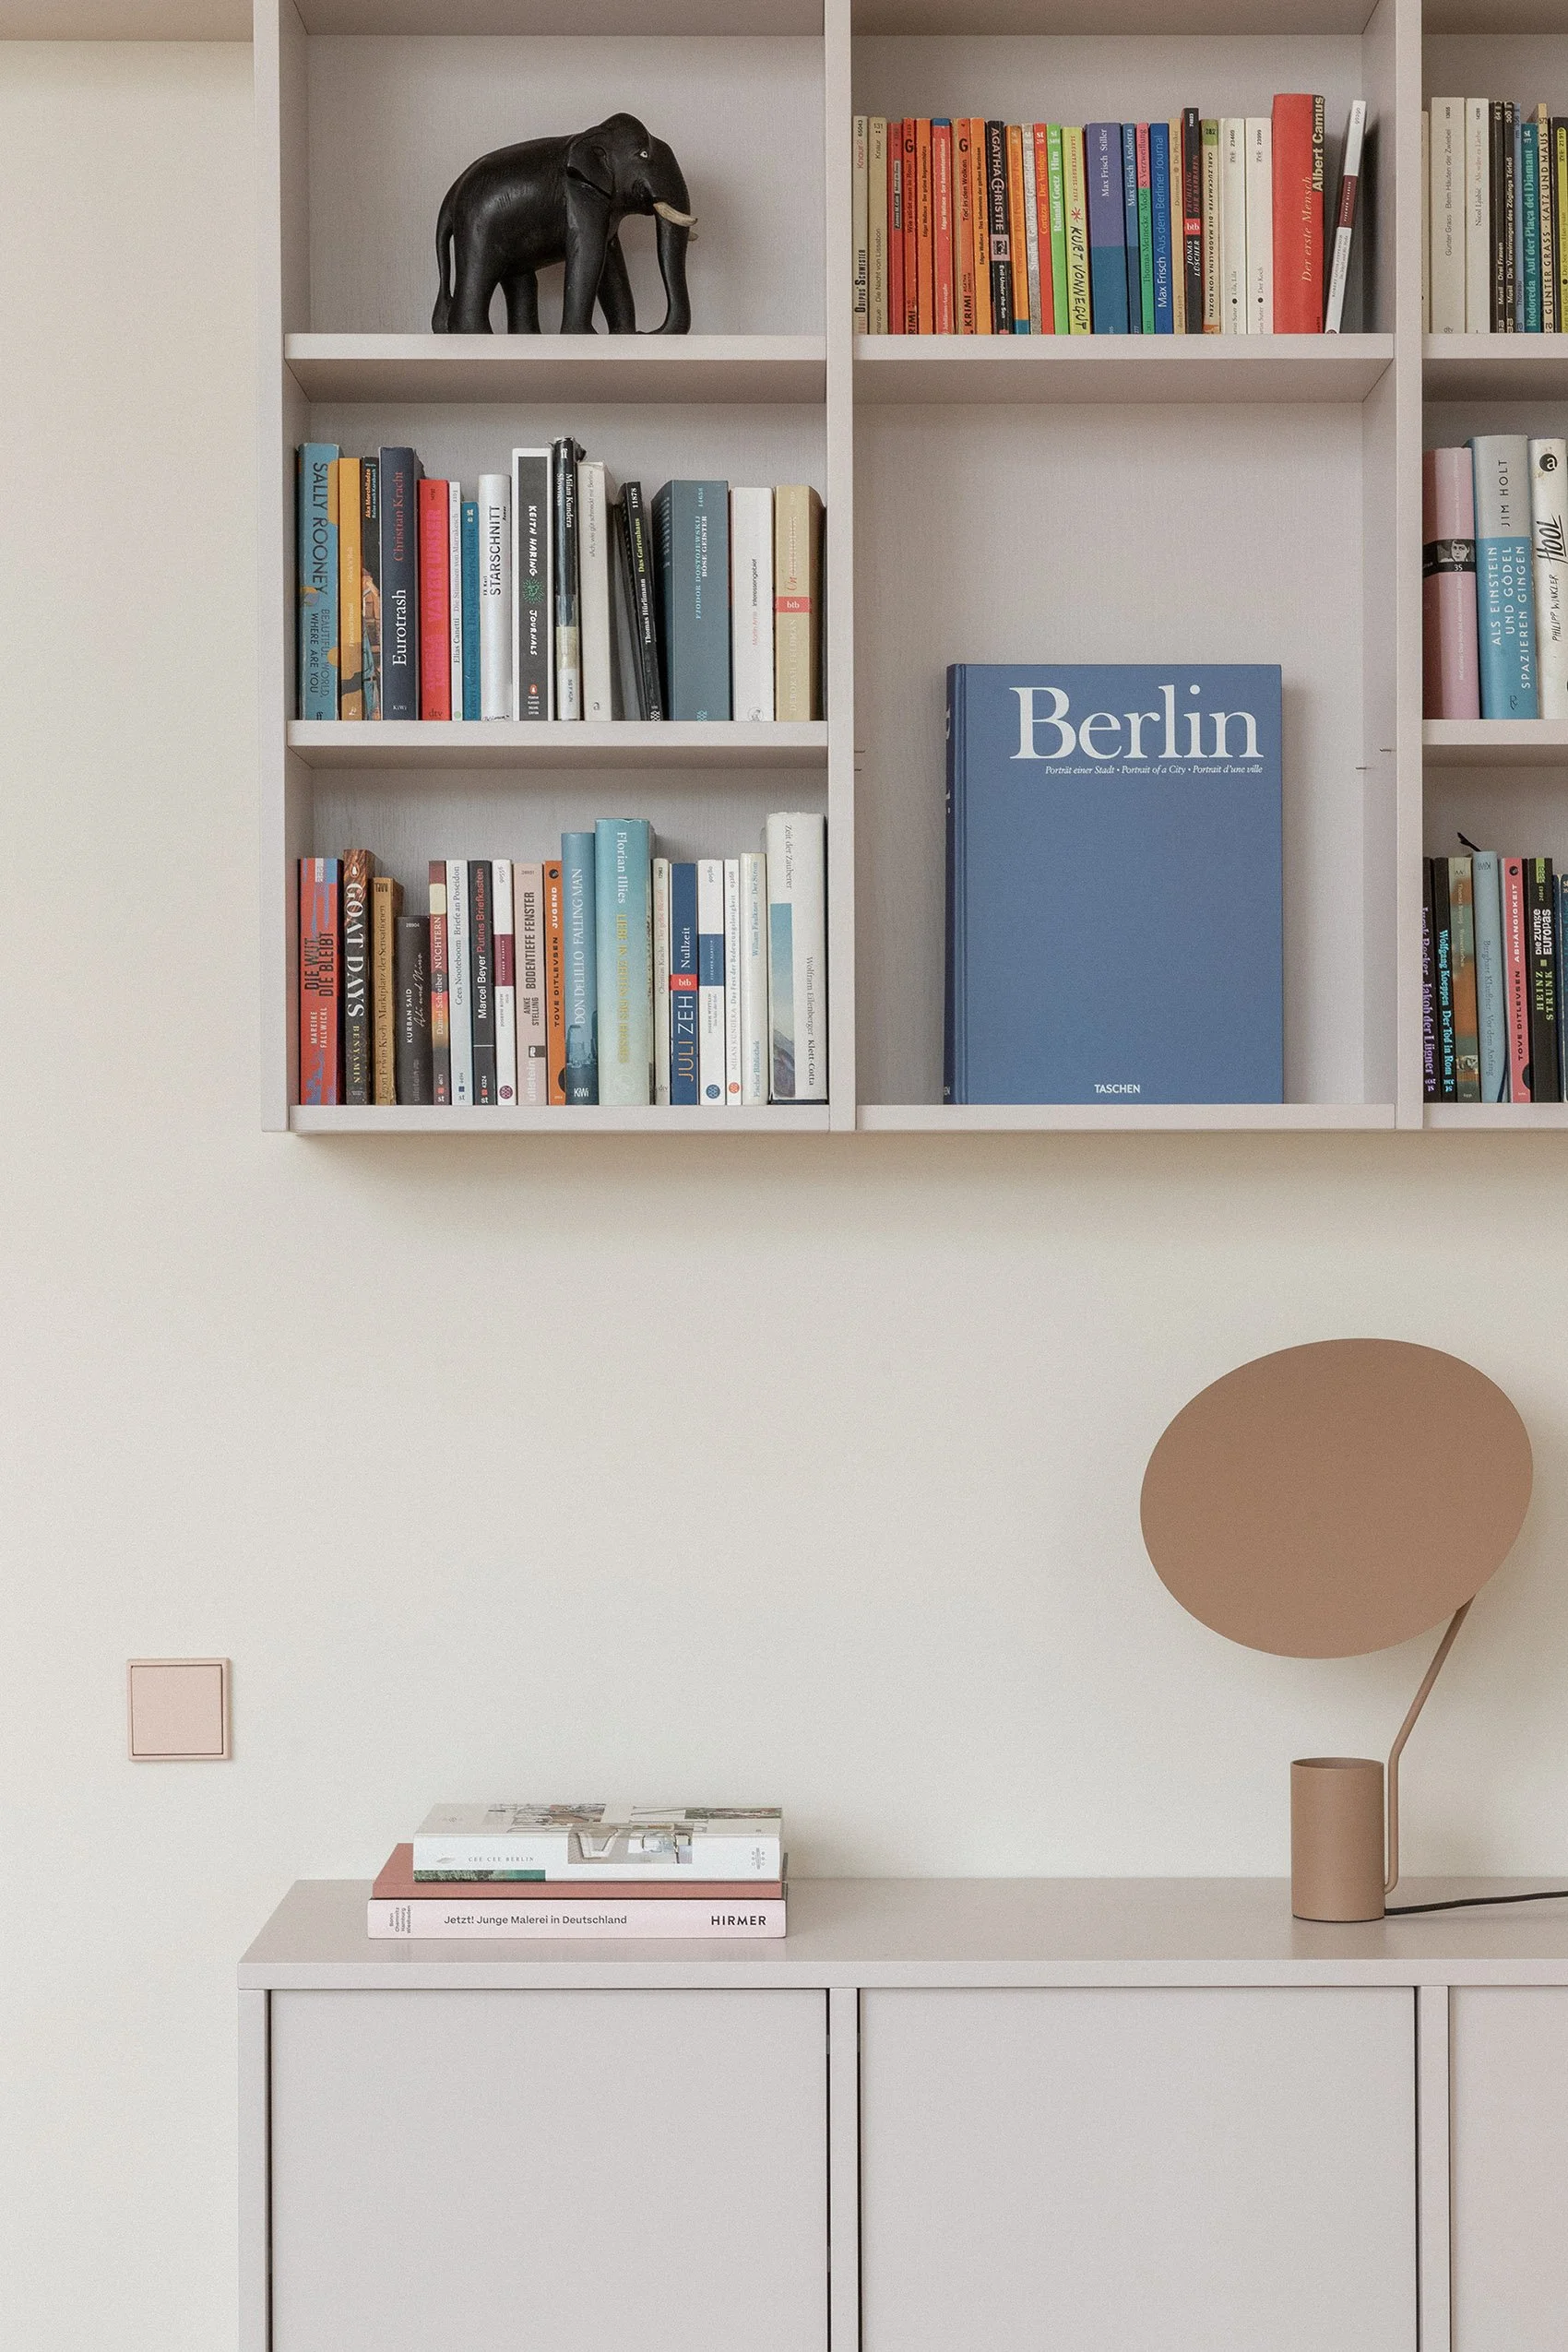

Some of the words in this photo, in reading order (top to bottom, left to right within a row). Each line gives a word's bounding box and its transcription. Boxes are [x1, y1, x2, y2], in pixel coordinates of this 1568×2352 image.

[1313, 96, 1324, 144] Camus
[991, 128, 1000, 177] AGATHA
[1099, 129, 1108, 150] Stiller
[1125, 129, 1134, 160] Andorra
[1154, 136, 1164, 170] Journal
[1539, 133, 1549, 162] MAUS
[1051, 151, 1059, 171] Hirn
[1100, 155, 1109, 178] Frisch
[1313, 148, 1324, 192] Albert
[1525, 150, 1534, 192] Diamant
[1540, 167, 1549, 189] UND
[1051, 175, 1062, 199] Goetz
[1101, 180, 1110, 196] Max
[1155, 173, 1164, 208] Berliner
[1301, 176, 1312, 222] Mensch
[1525, 194, 1535, 208] del
[992, 178, 1005, 231] CHRISTIE
[1052, 202, 1062, 232] Rainald
[1541, 192, 1550, 220] KATZ
[1156, 212, 1165, 232] dem
[1526, 210, 1537, 235] Plaça
[1070, 226, 1084, 260] KURT
[1156, 234, 1165, 254] Aus
[1302, 228, 1312, 255] erste
[1526, 237, 1536, 255] der
[1542, 232, 1551, 267] GRASS
[1157, 256, 1167, 283] Frisch
[1301, 257, 1312, 281] Der
[1526, 255, 1536, 275] Auf
[1073, 265, 1087, 329] VONNEGUT
[1158, 286, 1167, 307] Max
[1526, 280, 1537, 327] Rodoreda
[1544, 271, 1553, 315] GÜNTER
[313, 462, 328, 510] SALLY
[393, 471, 404, 507] Kracht
[556, 473, 564, 506] Slowness
[565, 473, 574, 495] Milan
[1498, 459, 1509, 496] HOLT
[565, 497, 574, 528] Kundera
[631, 487, 639, 509] 11878
[528, 505, 538, 535] KEITH
[1500, 505, 1511, 527] JIM
[393, 510, 405, 562] Christian
[489, 505, 501, 596] STARSCHNITT
[634, 518, 644, 558] Gartenhaus
[1536, 513, 1566, 563] HOOL
[312, 517, 328, 596] ROONEY
[528, 538, 538, 576] HARING
[1501, 546, 1514, 597] GÖDEL
[1515, 545, 1527, 602] GINGEN
[1488, 546, 1500, 612] EINSTEIN
[1548, 575, 1561, 609] WINKLER
[639, 578, 649, 616] Hürlimann
[310, 613, 319, 647] WHERE
[320, 609, 330, 658] BEAUTIFUL
[392, 589, 407, 666] Eurotrash
[528, 610, 538, 656] JOURNALS
[643, 616, 652, 644] Thomas
[1491, 620, 1502, 646] ALS
[1503, 605, 1515, 634] UND
[1550, 612, 1562, 642] PHILIPP
[310, 650, 319, 669] ARE
[1518, 611, 1531, 689] SPAZIEREN
[310, 671, 319, 694] YOU
[320, 661, 330, 698] WORLD,
[1009, 683, 1265, 760] Berlin
[1045, 765, 1073, 775] Porträt
[1074, 766, 1093, 775] einer
[1094, 765, 1114, 775] Stadt
[1122, 765, 1150, 775] Portrait
[1152, 765, 1161, 776] of
[1169, 765, 1186, 776] City
[1193, 765, 1221, 775] Portrait
[1223, 765, 1244, 775] d'une
[1246, 765, 1263, 774] ville
[616, 832, 626, 873] Florian
[452, 866, 461, 900] Poseidon
[475, 868, 485, 921] Briefkasten
[572, 869, 583, 897] MAN
[617, 875, 628, 904] Illies
[345, 884, 364, 950] GOAT
[452, 914, 462, 935] Briefe
[455, 902, 461, 913] an
[524, 892, 536, 932] FENSTER
[573, 899, 584, 944] FALLING
[1511, 884, 1520, 963] ABHÄNGIGKEIT
[433, 917, 442, 968] NÜCHTERN
[476, 923, 485, 953] Putins
[681, 927, 691, 968] Nullzeit
[1438, 930, 1449, 968] Wolfgang
[1542, 909, 1552, 955] Europas
[319, 932, 333, 971] BLEIBT
[453, 940, 463, 985] Nooteboom
[524, 933, 536, 990] BODENTIEFE
[304, 971, 319, 990] DIE
[346, 956, 364, 1017] DAYS
[476, 956, 488, 983] Beyer
[805, 956, 814, 991] Wolfram
[319, 978, 333, 996] DIE
[434, 973, 443, 1008] Schreiber
[455, 987, 463, 1005] Cees
[476, 985, 488, 1018] Marcel
[1440, 970, 1450, 1005] Koeppen
[1515, 970, 1523, 1029] DITLEVSEN
[1536, 971, 1544, 1010] HEINZ
[1545, 971, 1553, 1020] STRUNK
[435, 1010, 444, 1035] Daniel
[523, 997, 531, 1015] ANKE
[530, 997, 540, 1026] STELLING
[574, 1000, 586, 1024] DON
[677, 995, 694, 1034] ZEH
[805, 992, 815, 1036] Eilenberger
[1442, 1010, 1452, 1026] Der
[1443, 1028, 1453, 1044] Tod
[352, 1025, 361, 1084] BENYAMIN
[678, 1040, 695, 1082] JULI
[807, 1039, 816, 1086] Klett-Cotta
[1444, 1055, 1454, 1075] Rom
[1094, 1084, 1140, 1093] TASCHEN
[444, 1915, 474, 1925] Jetzt!
[476, 1915, 508, 1927] Junge
[510, 1915, 548, 1925] Malerei
[551, 1915, 560, 1925] in
[562, 1914, 627, 1925] Deutschland
[711, 1916, 766, 1926] HIRMER
